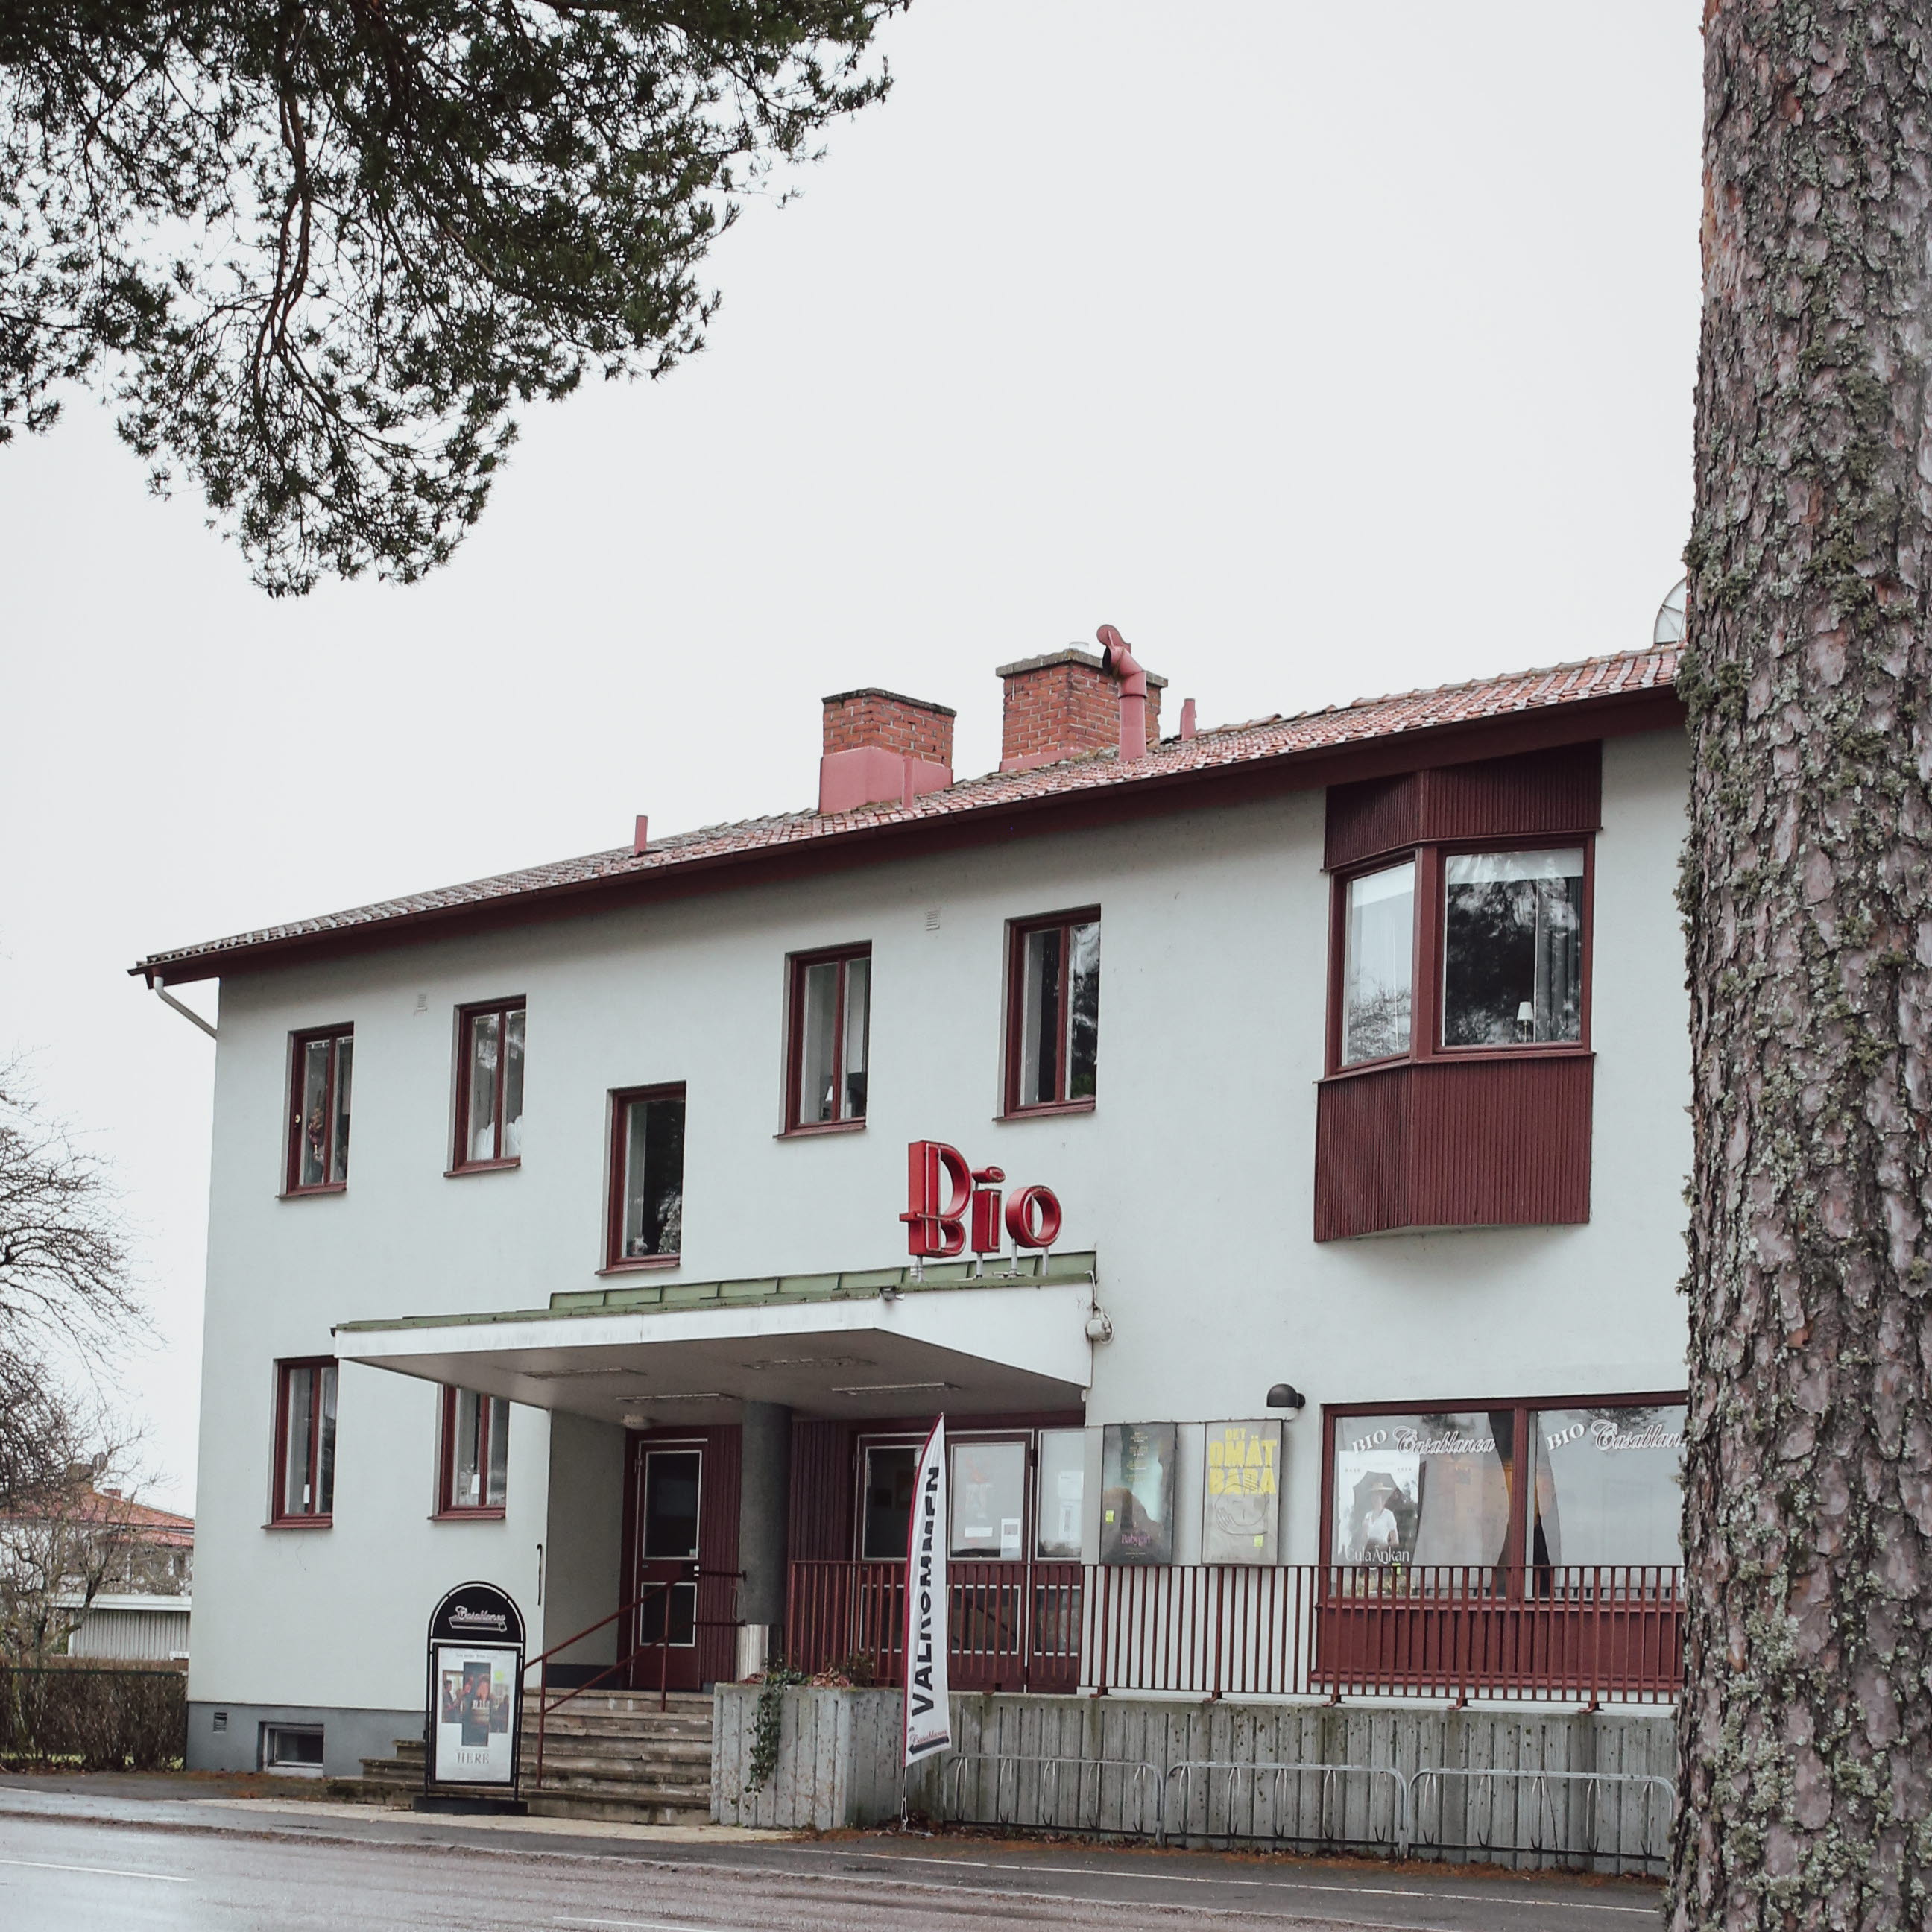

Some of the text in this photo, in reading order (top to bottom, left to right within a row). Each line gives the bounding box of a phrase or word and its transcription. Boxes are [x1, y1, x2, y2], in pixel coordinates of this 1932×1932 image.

[900, 1140, 1063, 1258] Bio
[1351, 1425, 1496, 1455] BIO Casablanca
[1547, 1419, 1687, 1451] BIO Casablan
[1209, 1435, 1278, 1468] OMÄT
[456, 1752, 490, 1764] HERE
